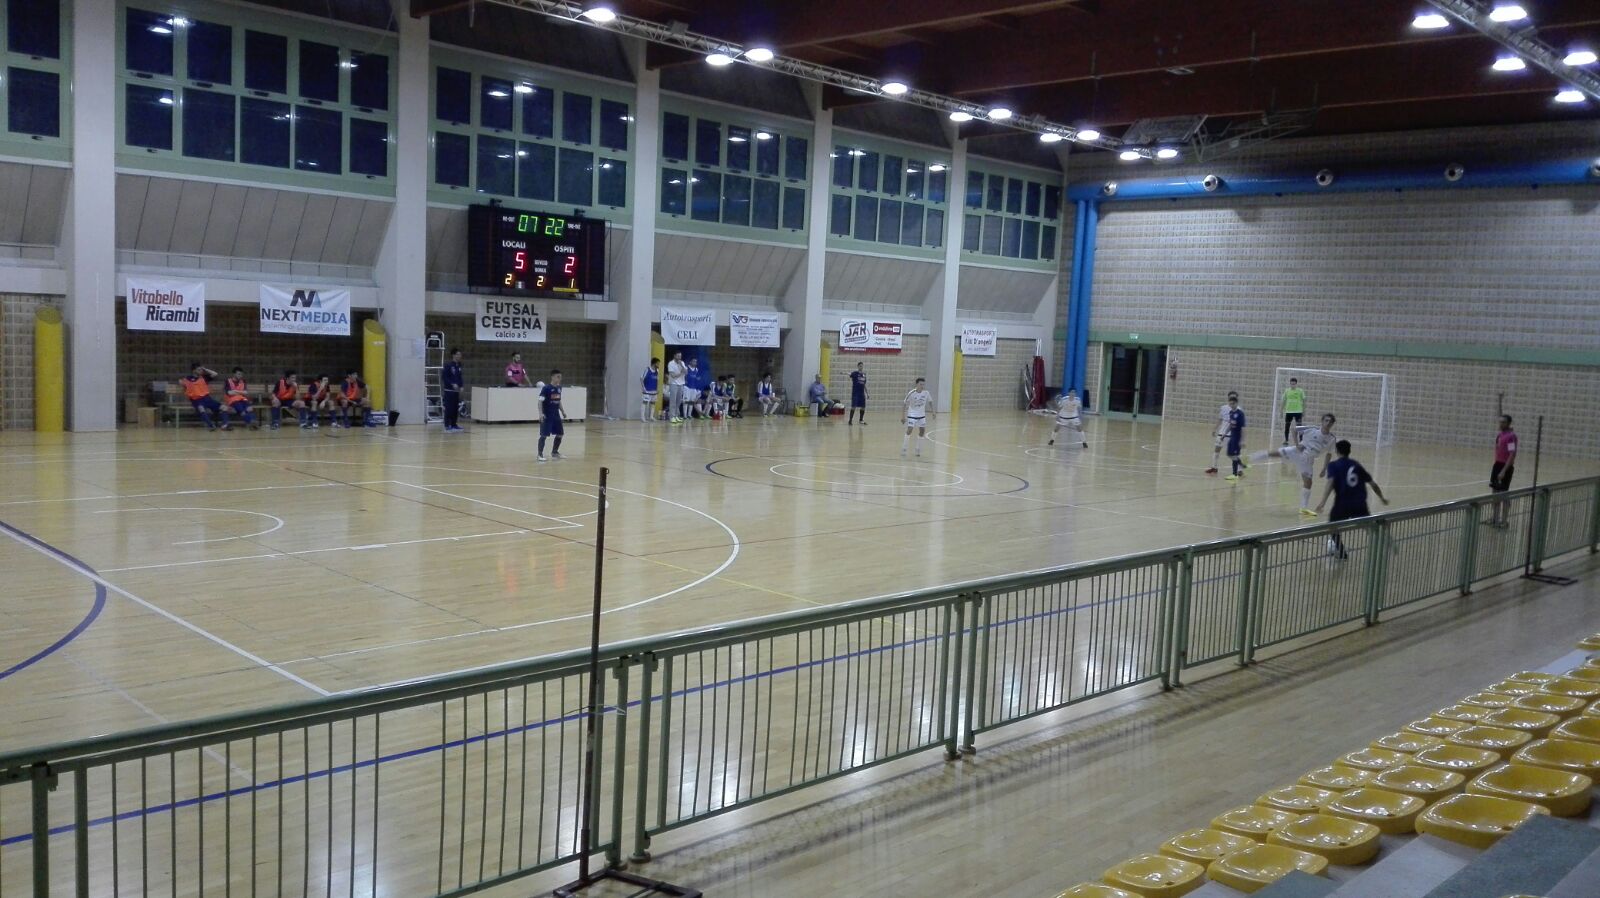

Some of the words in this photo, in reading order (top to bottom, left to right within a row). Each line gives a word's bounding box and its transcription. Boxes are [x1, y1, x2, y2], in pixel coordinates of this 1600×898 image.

[518, 214, 538, 233] 07
[544, 217, 565, 236] 22
[502, 239, 526, 249] LOCALI
[554, 245, 574, 253] OSPITI
[515, 252, 525, 269] 5
[564, 256, 575, 273] 2
[504, 273, 513, 285] 2
[536, 275, 545, 287] 2
[131, 287, 184, 306] Vitobello
[145, 305, 200, 323] Ricambi
[261, 308, 348, 324] NEXTMEDIA
[486, 301, 539, 316] FUTSAL
[481, 315, 542, 330] CESENA
[495, 330, 515, 338] calcio
[677, 330, 698, 340] CELI
[1346, 465, 1359, 488] 6
